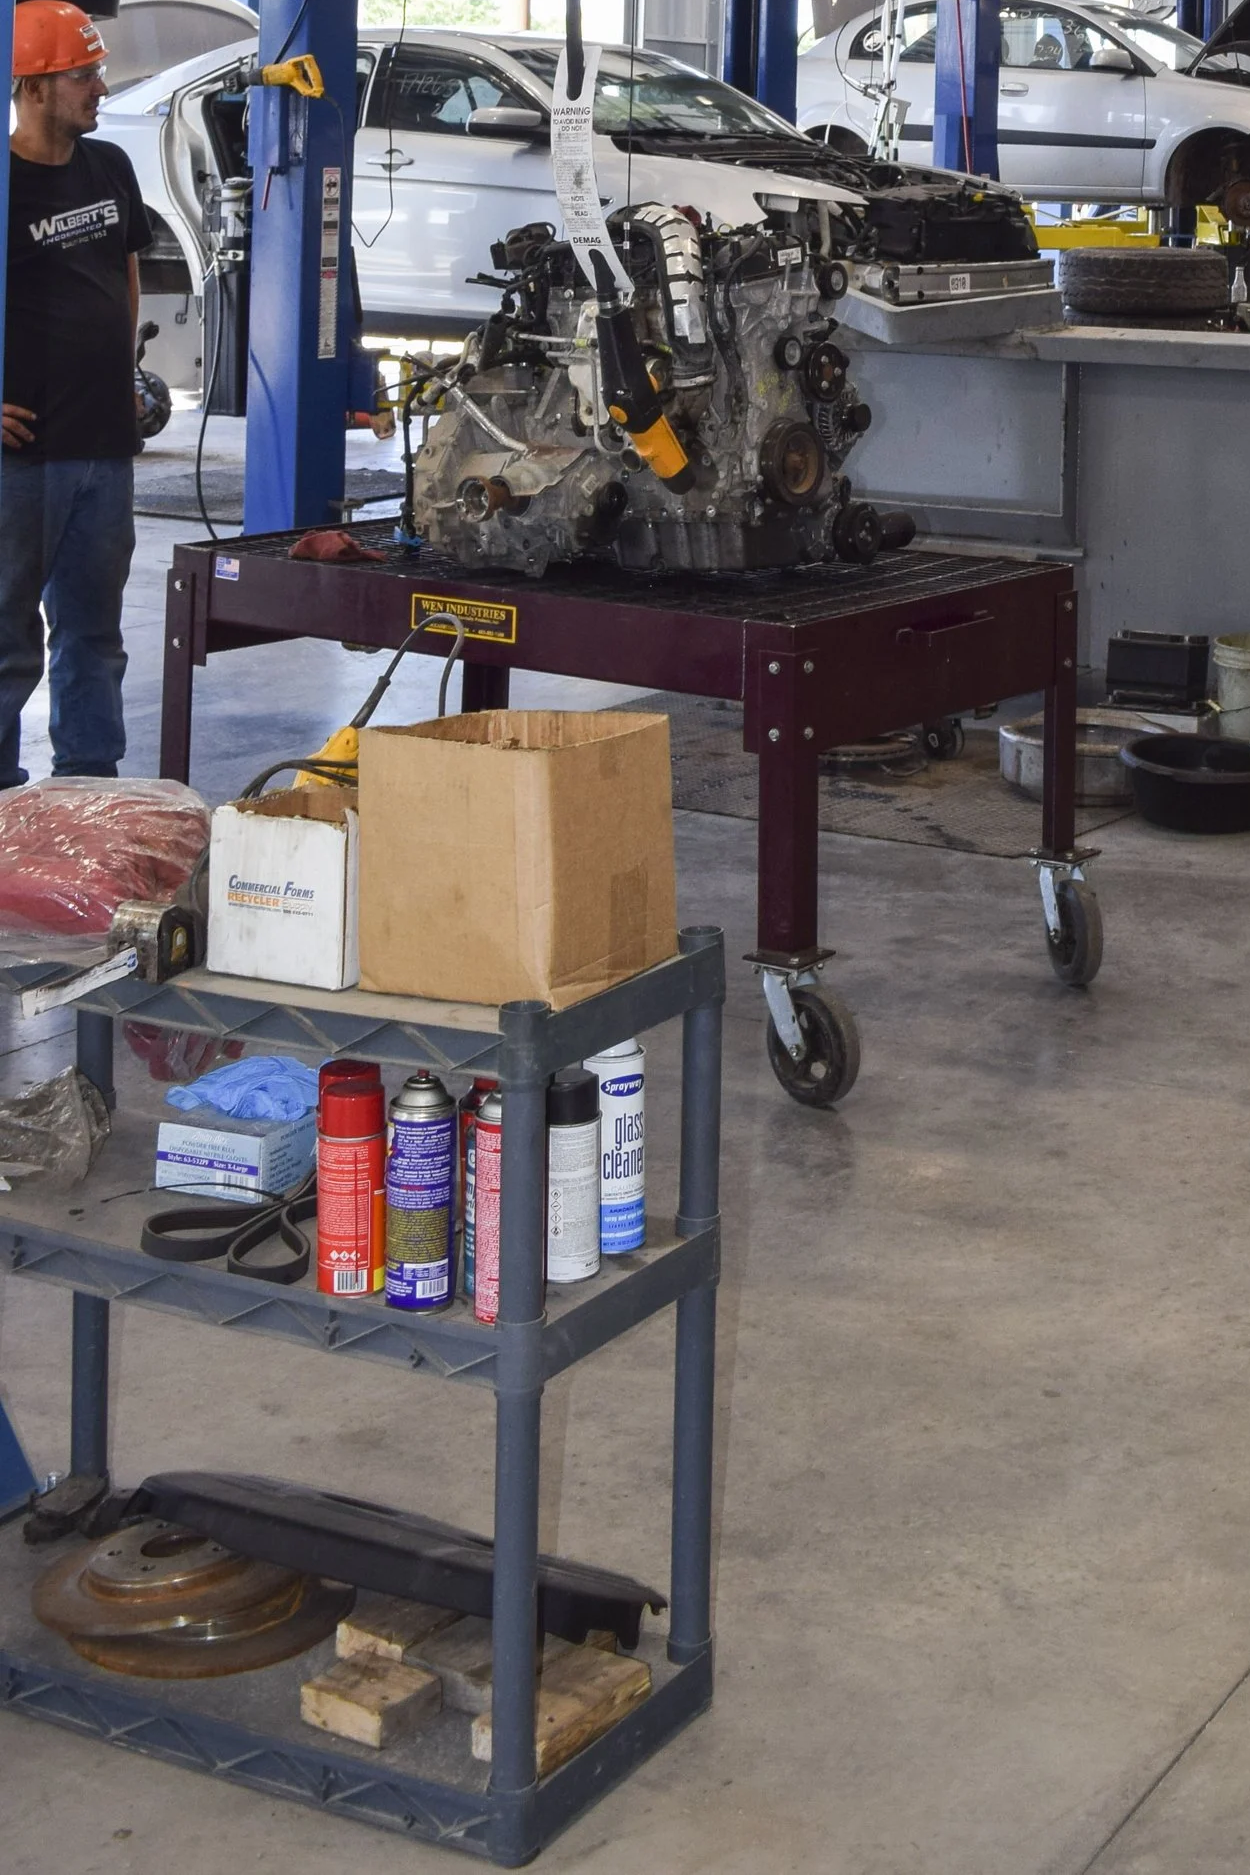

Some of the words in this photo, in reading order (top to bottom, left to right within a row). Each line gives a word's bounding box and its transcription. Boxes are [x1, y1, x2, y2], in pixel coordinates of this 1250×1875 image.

[553, 106, 591, 116] WARNING
[29, 202, 119, 242] WILBERT'S
[421, 600, 444, 612] WEN
[446, 604, 506, 621] INDUSTRIES
[228, 874, 281, 895] COMMERCIAL
[283, 881, 315, 899] FORMS
[227, 892, 280, 907] RECYCLER
[605, 1078, 642, 1094] Sprayway
[615, 1111, 644, 1151] glass
[167, 1153, 182, 1162] Style:
